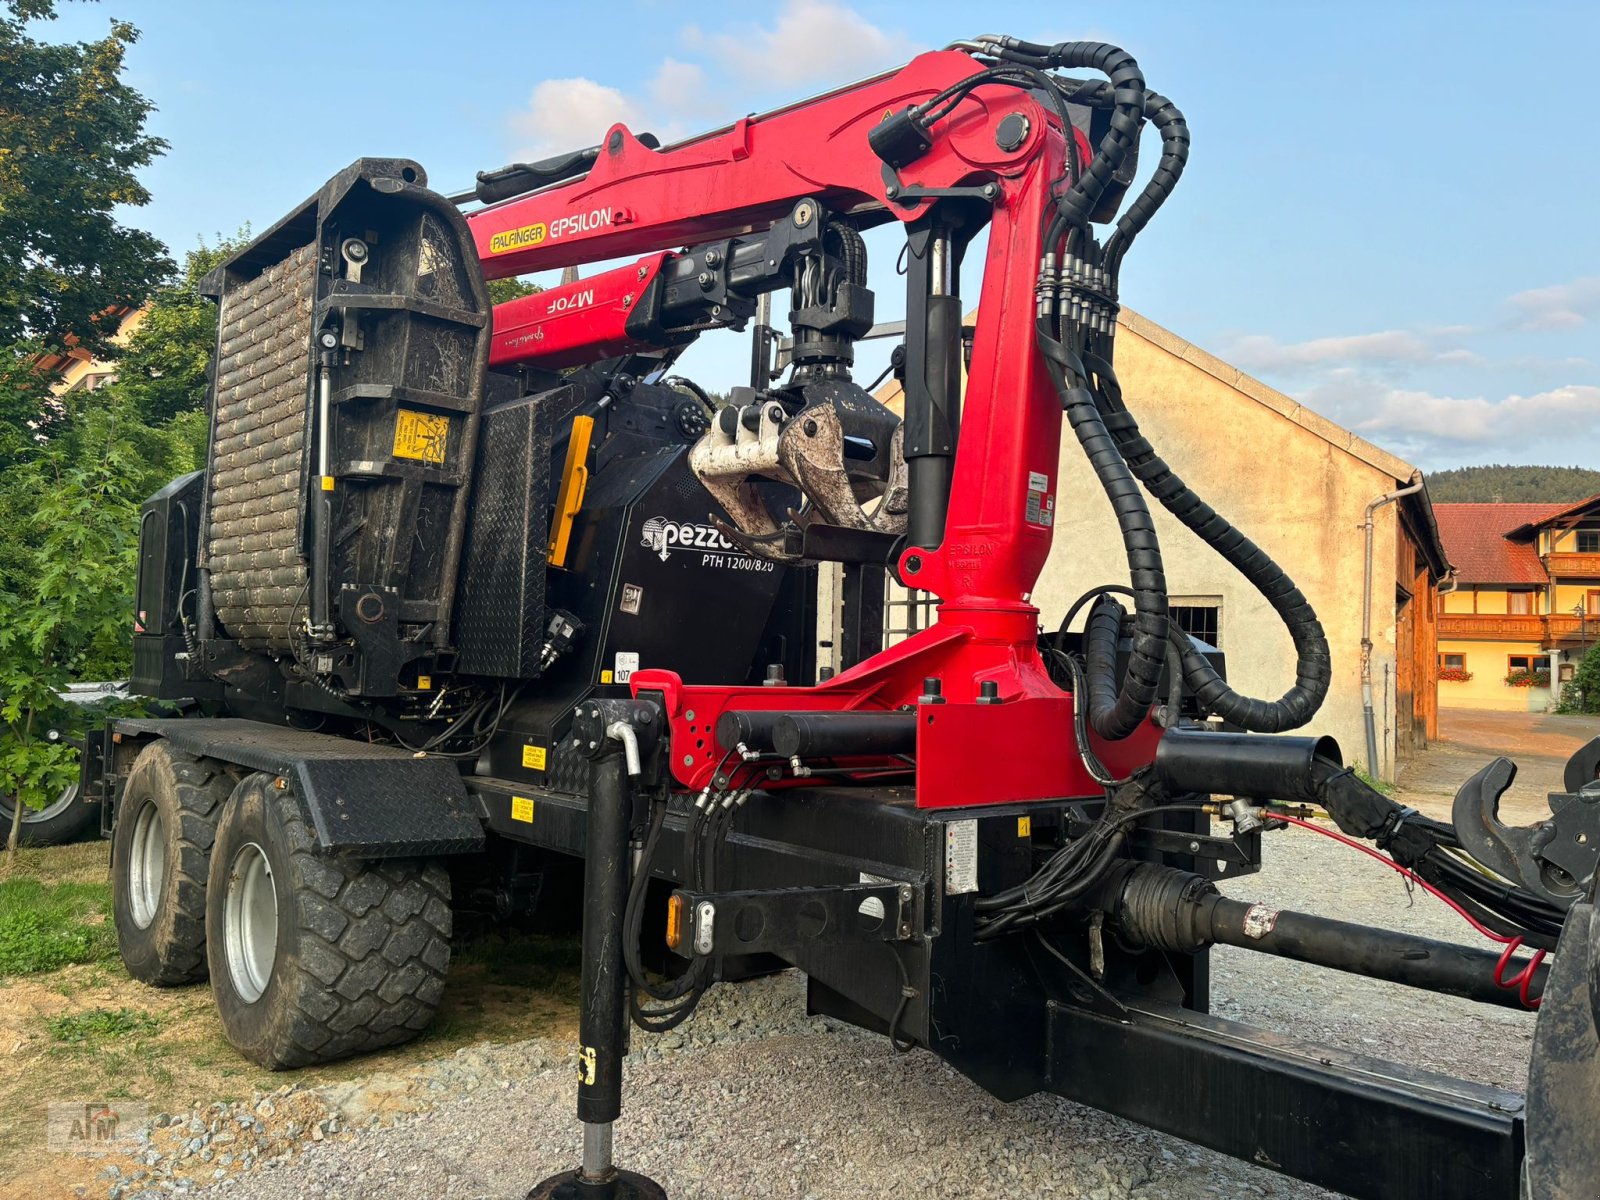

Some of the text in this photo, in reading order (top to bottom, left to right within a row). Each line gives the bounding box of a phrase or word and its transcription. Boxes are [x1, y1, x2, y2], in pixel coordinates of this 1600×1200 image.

[492, 207, 612, 249] PALFINGER EPSILON
[546, 289, 594, 315] M70F
[701, 554, 774, 572] PTH 1200/820
[617, 670, 630, 681] 107
